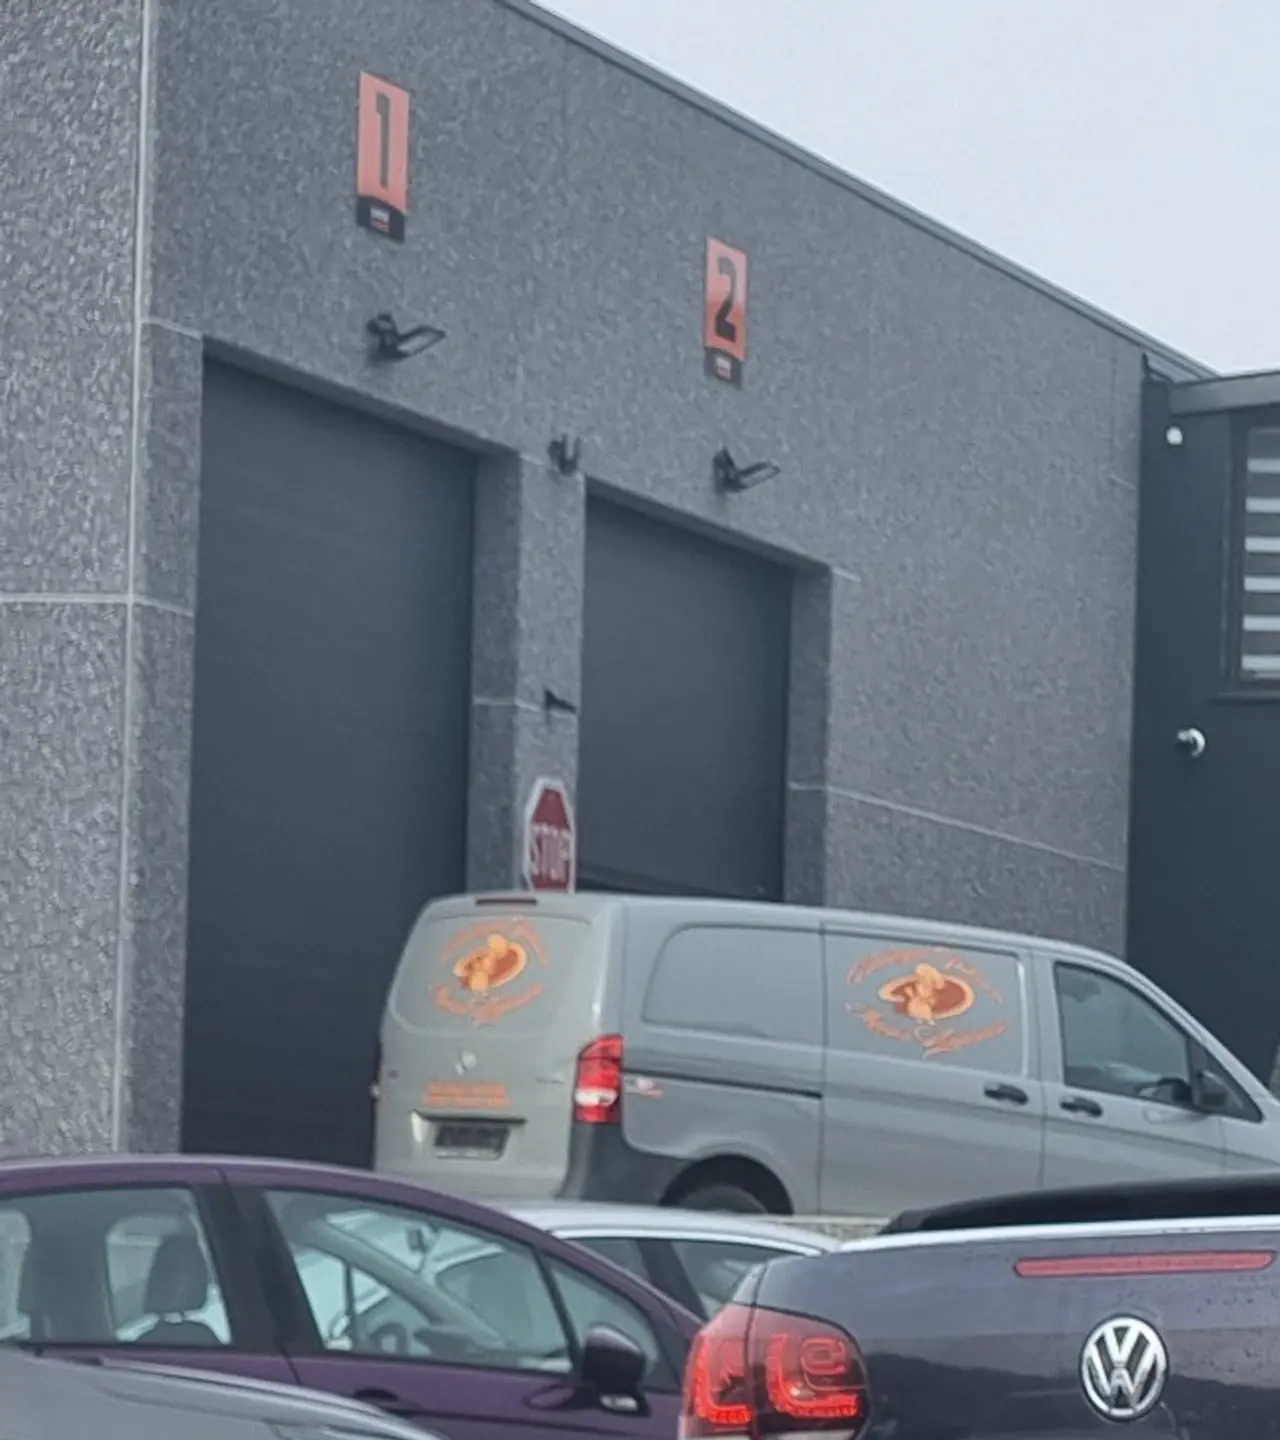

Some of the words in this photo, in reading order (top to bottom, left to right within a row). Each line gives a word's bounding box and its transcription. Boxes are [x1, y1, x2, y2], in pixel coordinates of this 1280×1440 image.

[375, 92, 391, 189] 1
[715, 256, 737, 343] 2
[530, 822, 571, 882] STOP
